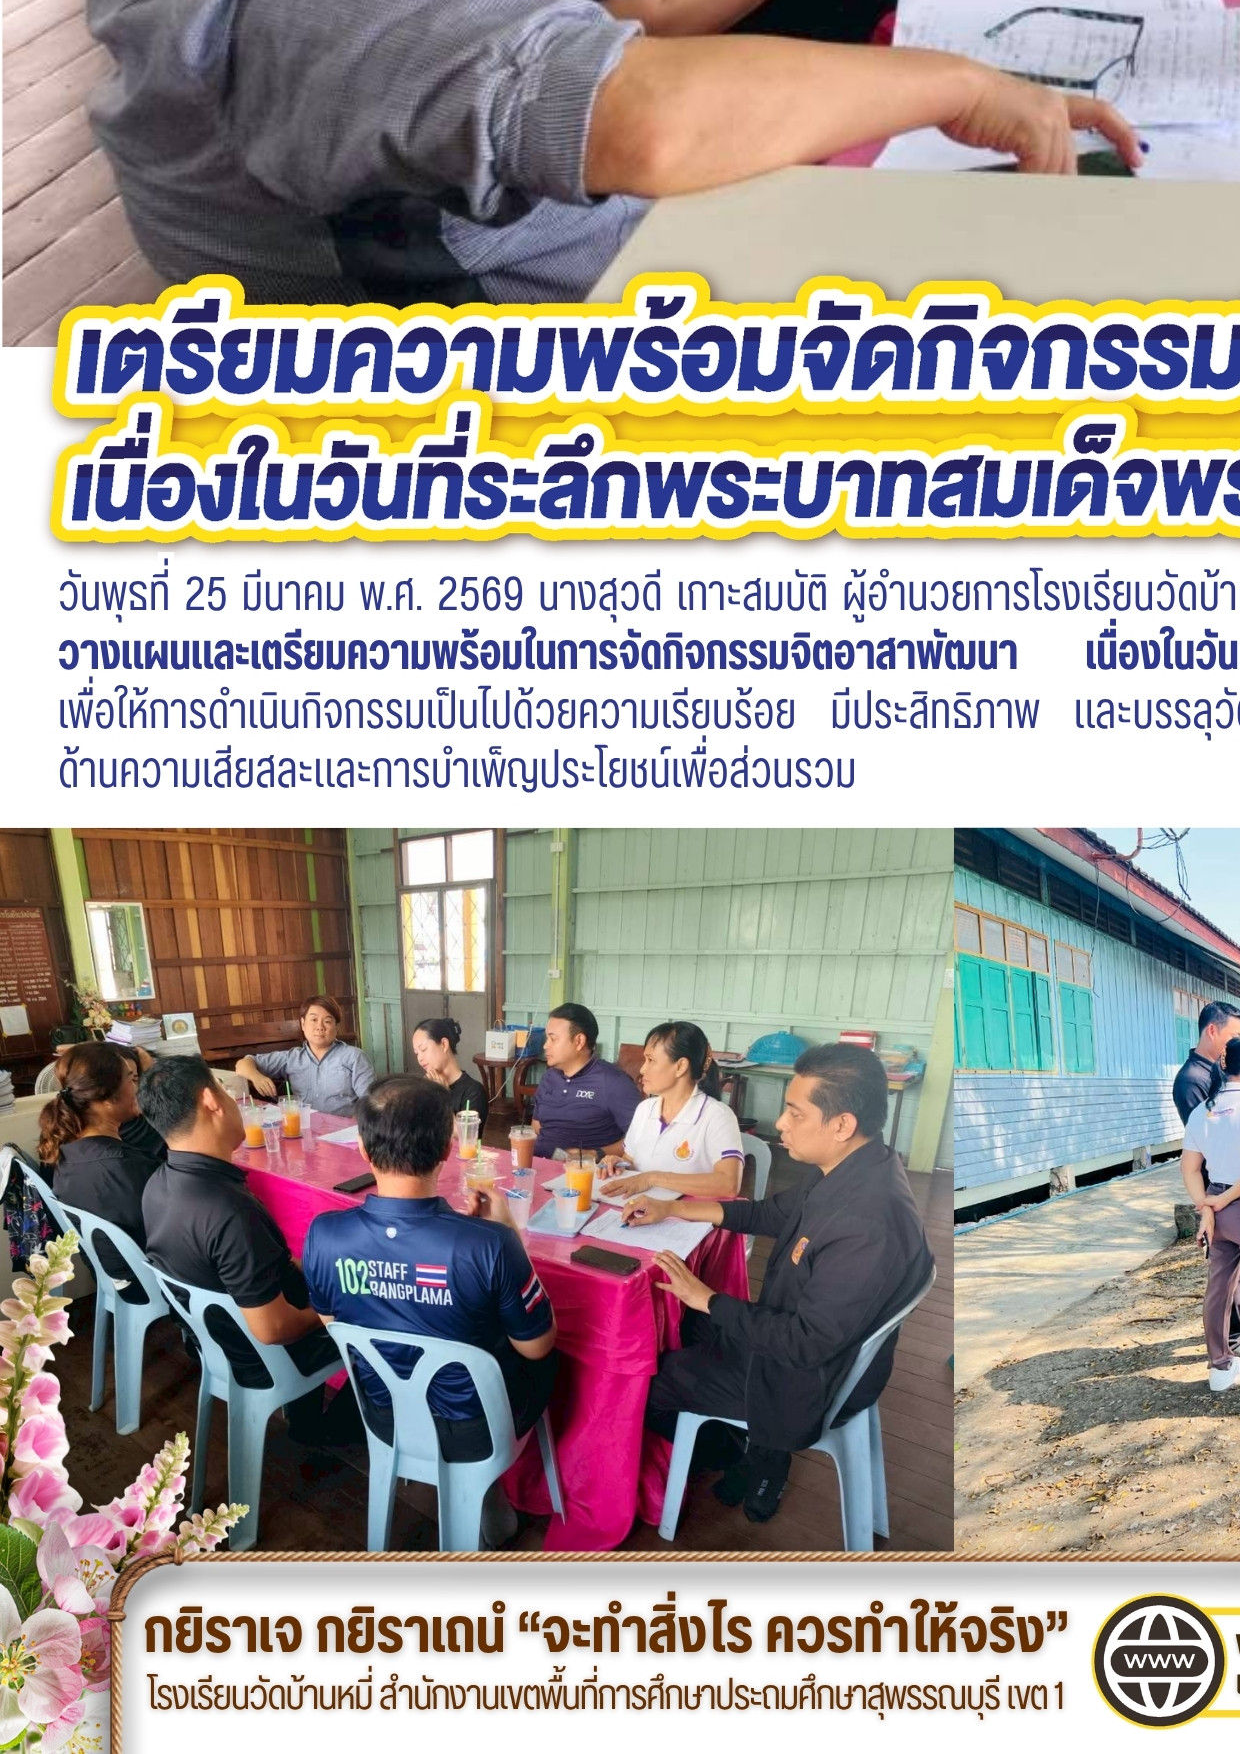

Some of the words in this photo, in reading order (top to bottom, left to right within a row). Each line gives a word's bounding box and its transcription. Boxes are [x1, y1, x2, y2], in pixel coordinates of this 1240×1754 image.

[335, 1257, 372, 1296] 102
[367, 1260, 408, 1281] STAFF
[369, 1280, 454, 1306] BANGPLAMA
